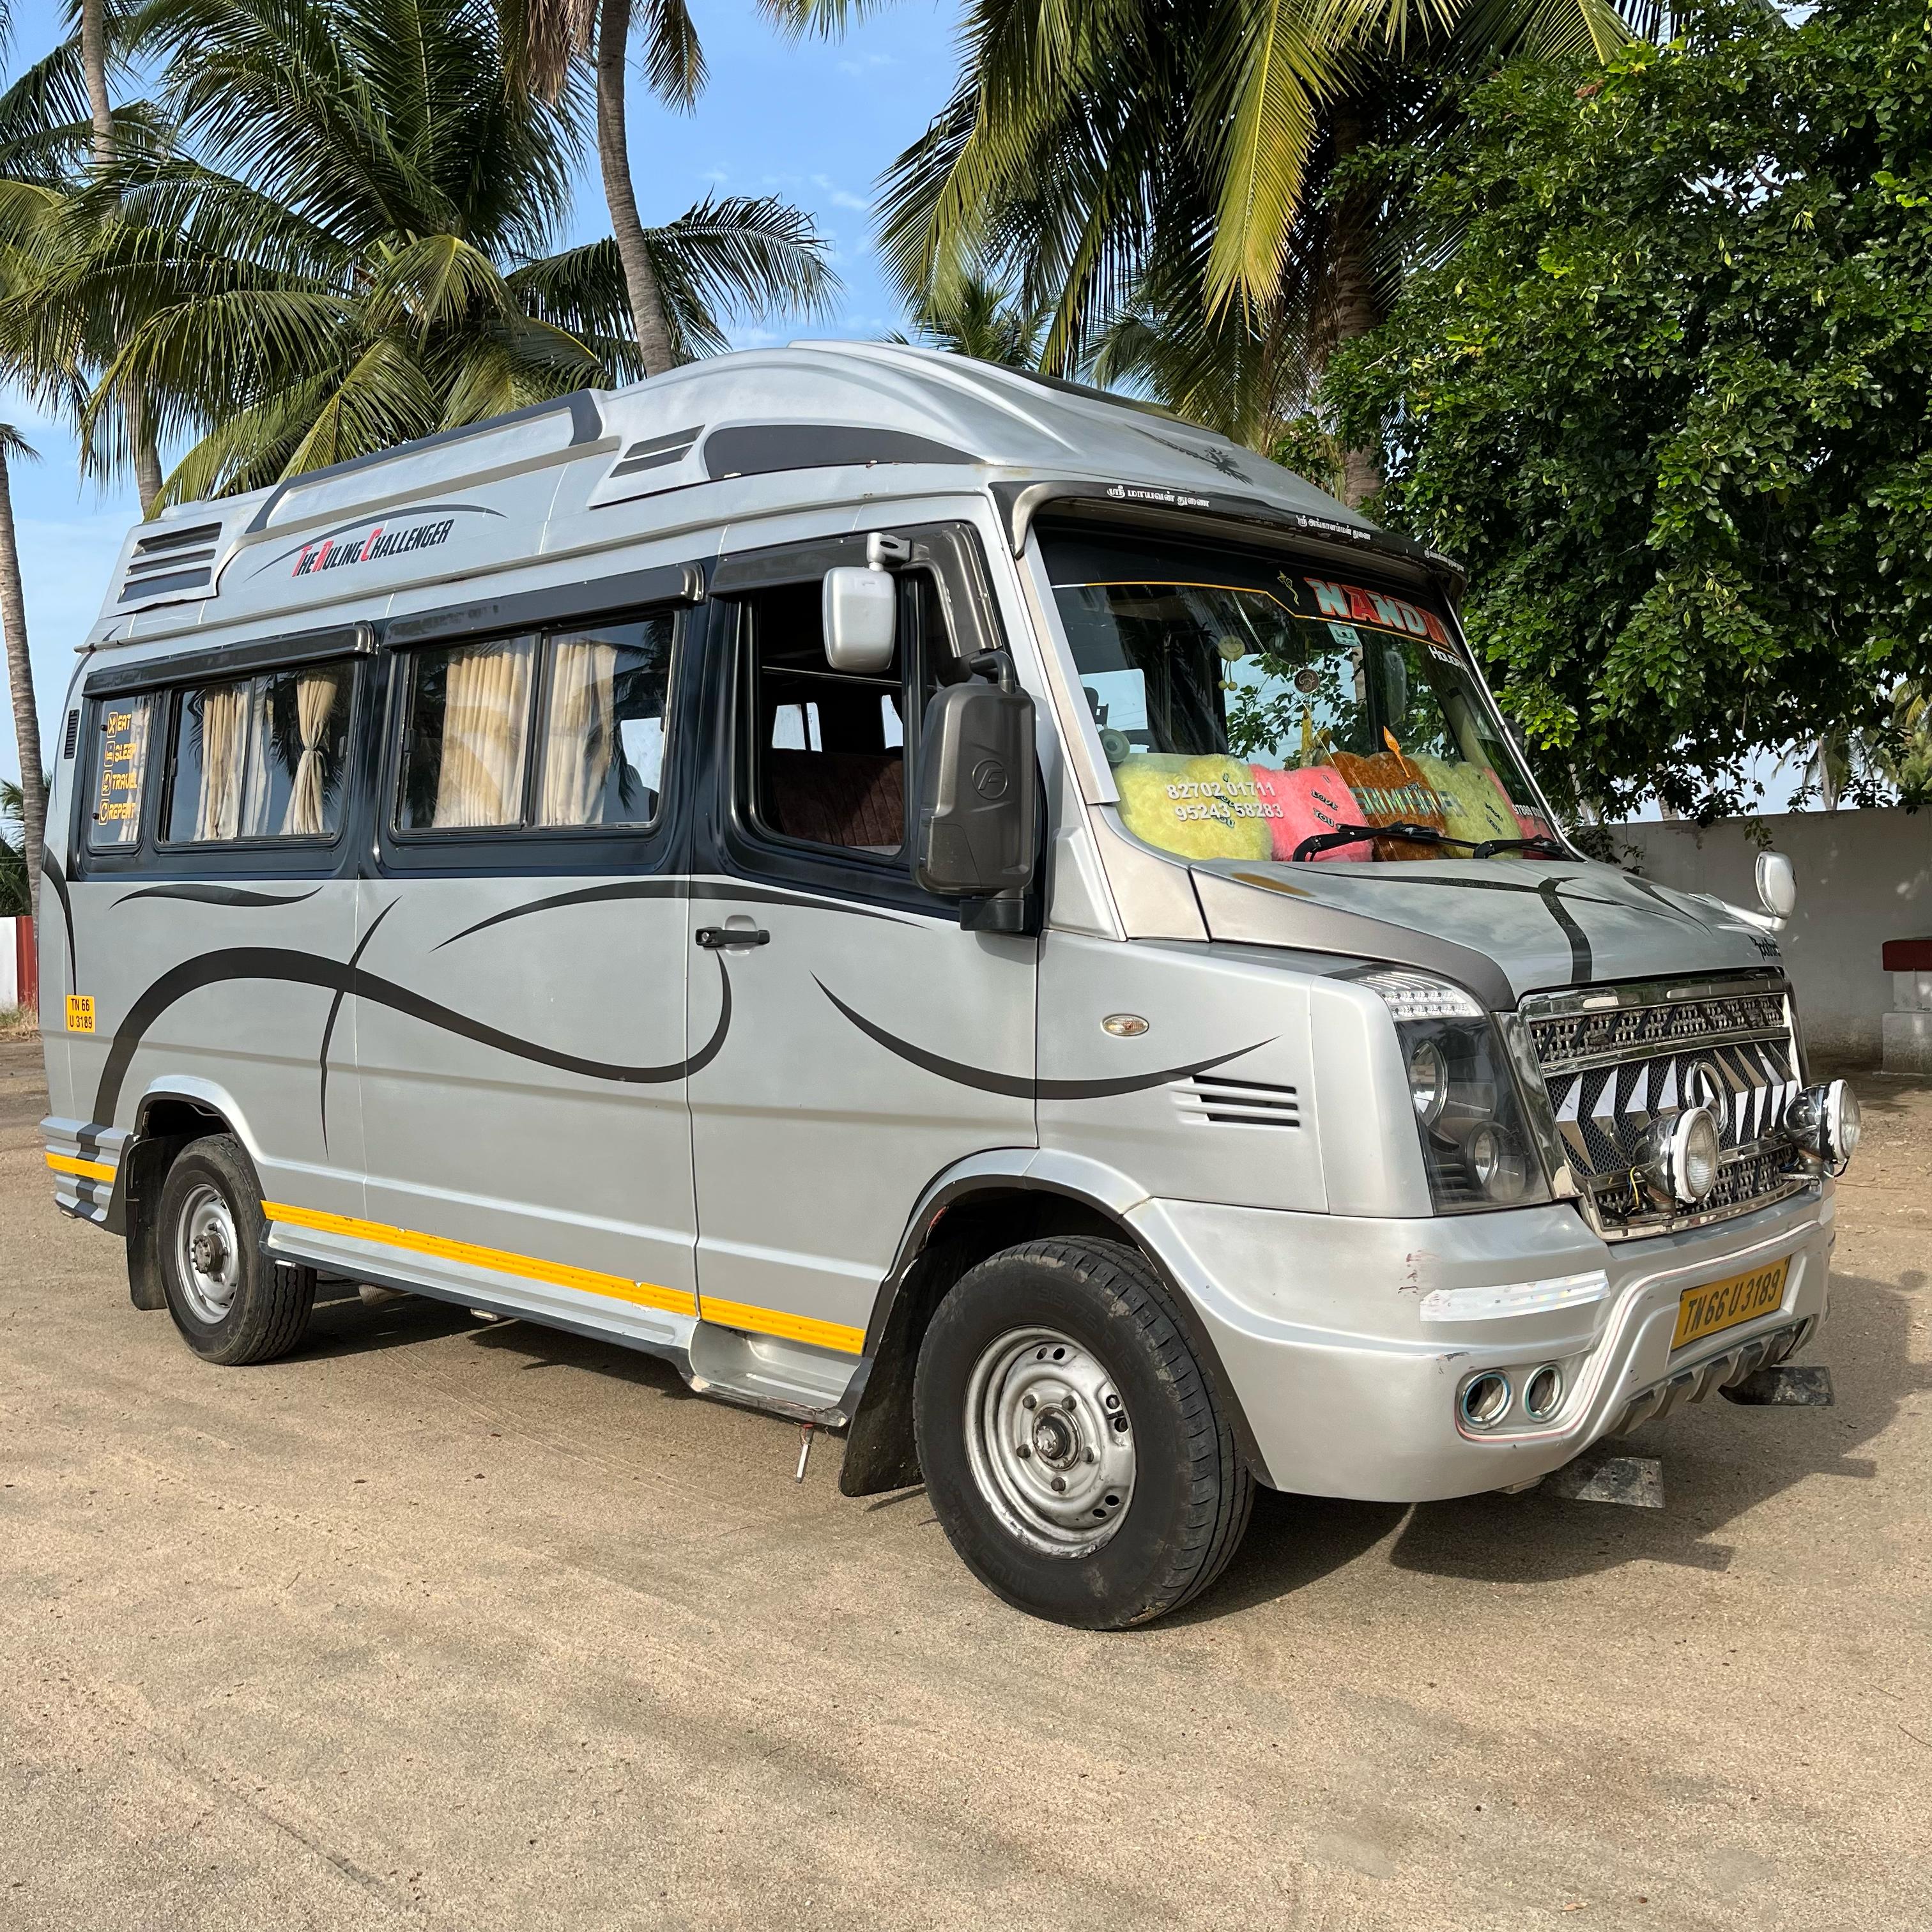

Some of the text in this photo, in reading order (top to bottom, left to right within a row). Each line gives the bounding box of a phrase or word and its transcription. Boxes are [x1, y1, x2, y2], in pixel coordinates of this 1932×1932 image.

[1177, 496, 1210, 507] துணை
[360, 519, 455, 562] CHALLENGER
[117, 714, 132, 731] EAT
[114, 742, 138, 763] SLEEP
[112, 770, 139, 790] TRAVEL
[1165, 781, 1276, 800] 82702 01711
[1174, 802, 1284, 821] 95243 58283
[1313, 807, 1335, 827] YOU
[70, 998, 90, 1012] TN 66
[69, 1015, 93, 1029] U 3189
[1683, 1268, 1781, 1336] TN 66 U 3189
